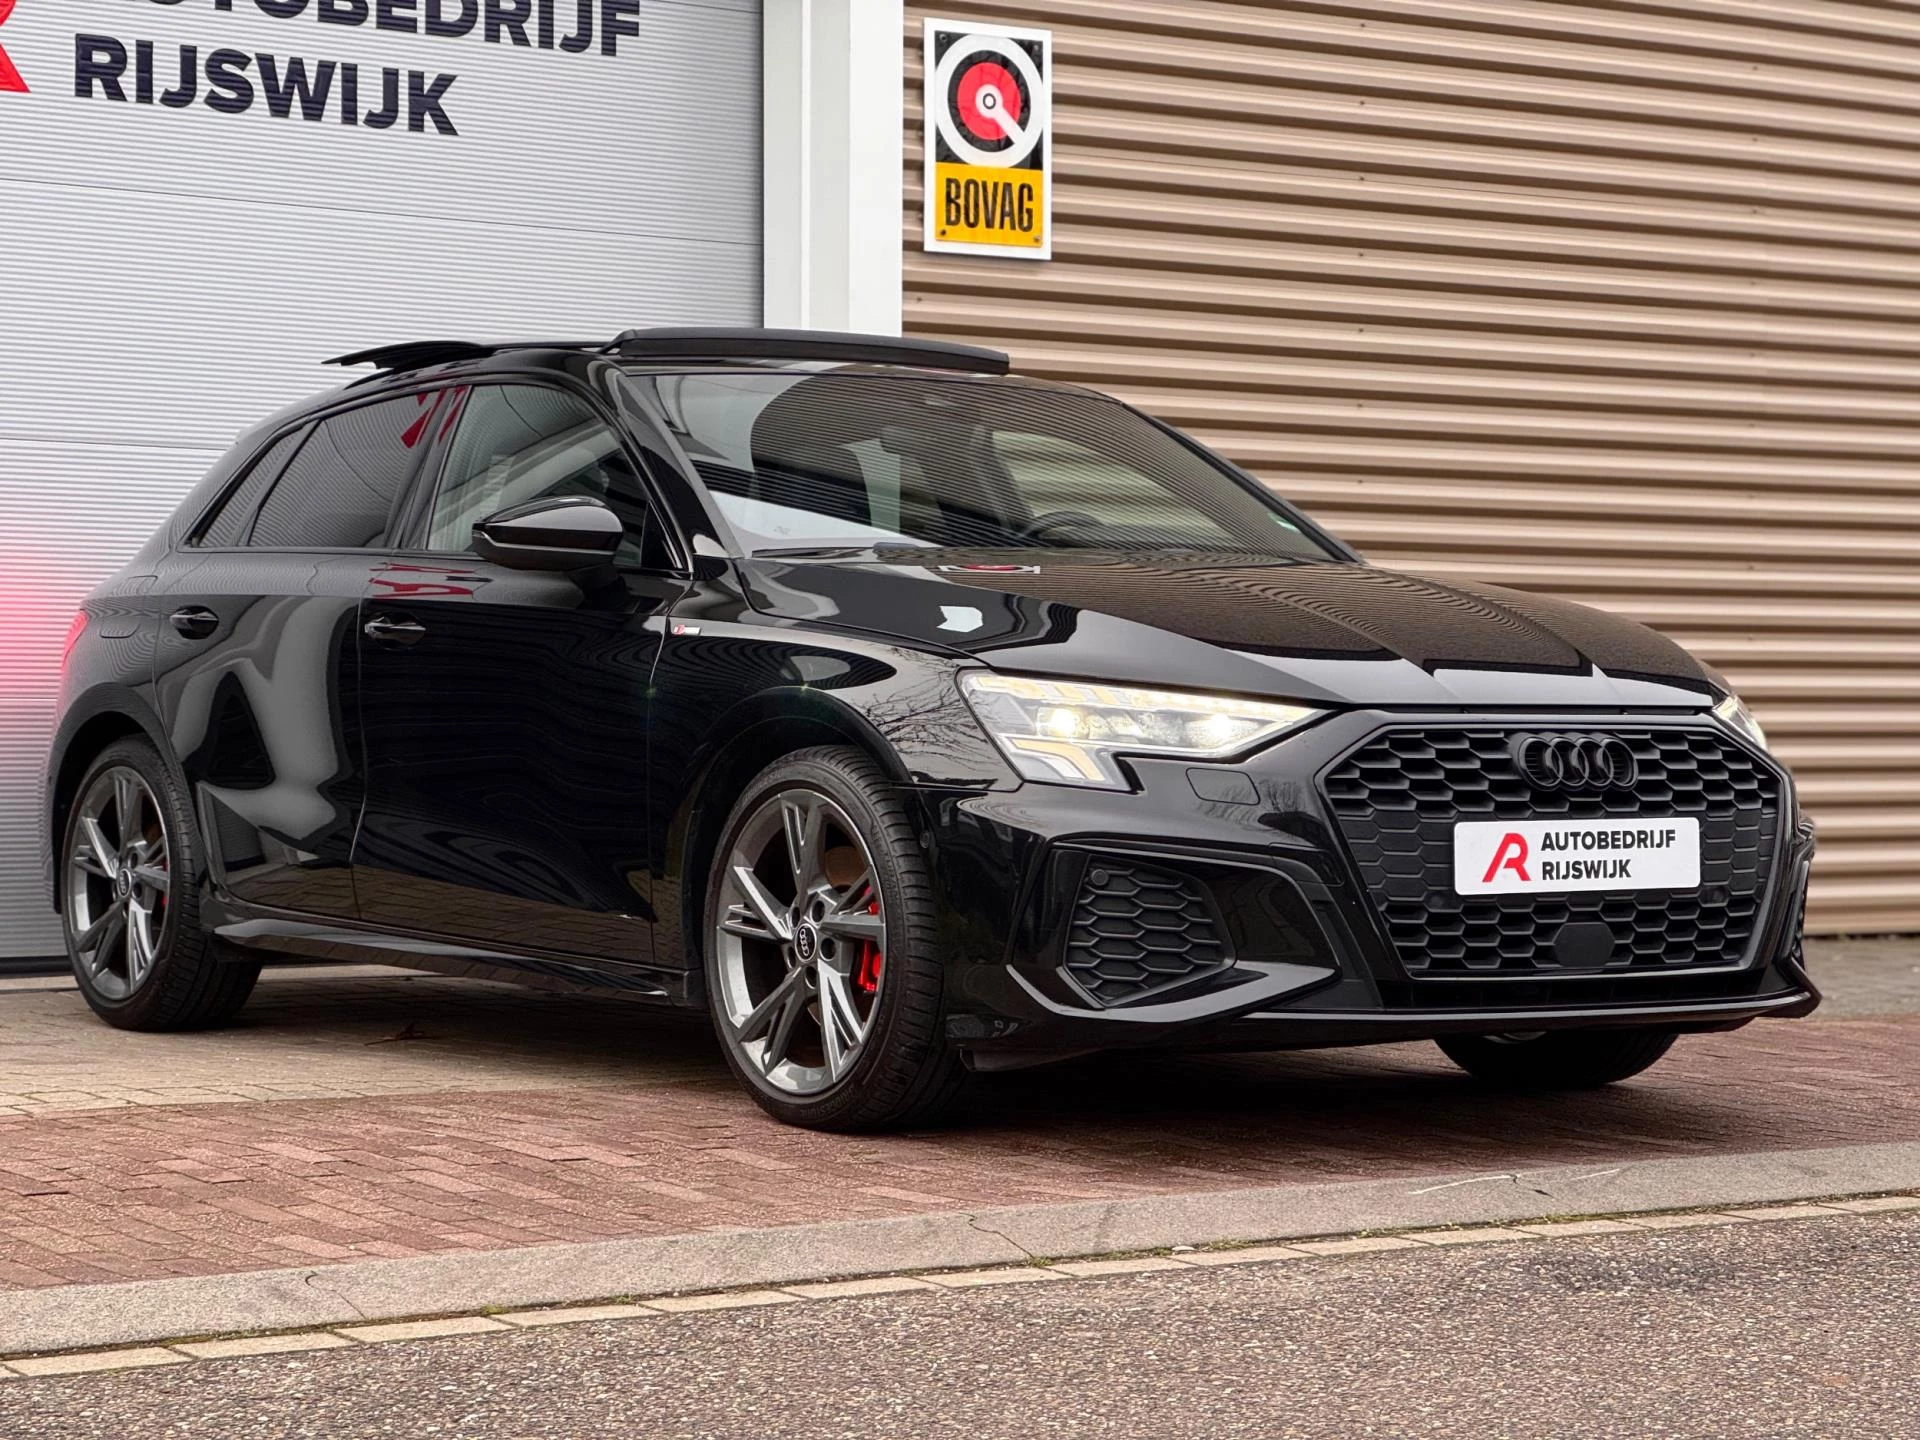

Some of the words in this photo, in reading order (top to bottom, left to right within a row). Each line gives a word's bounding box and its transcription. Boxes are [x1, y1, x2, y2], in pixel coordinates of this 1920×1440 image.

[74, 33, 459, 136] RIJSWIJK
[945, 178, 1033, 232] BOVAG
[1541, 829, 1676, 851] AUTOBEDRIJF
[1542, 859, 1632, 880] RIJSWIJK
